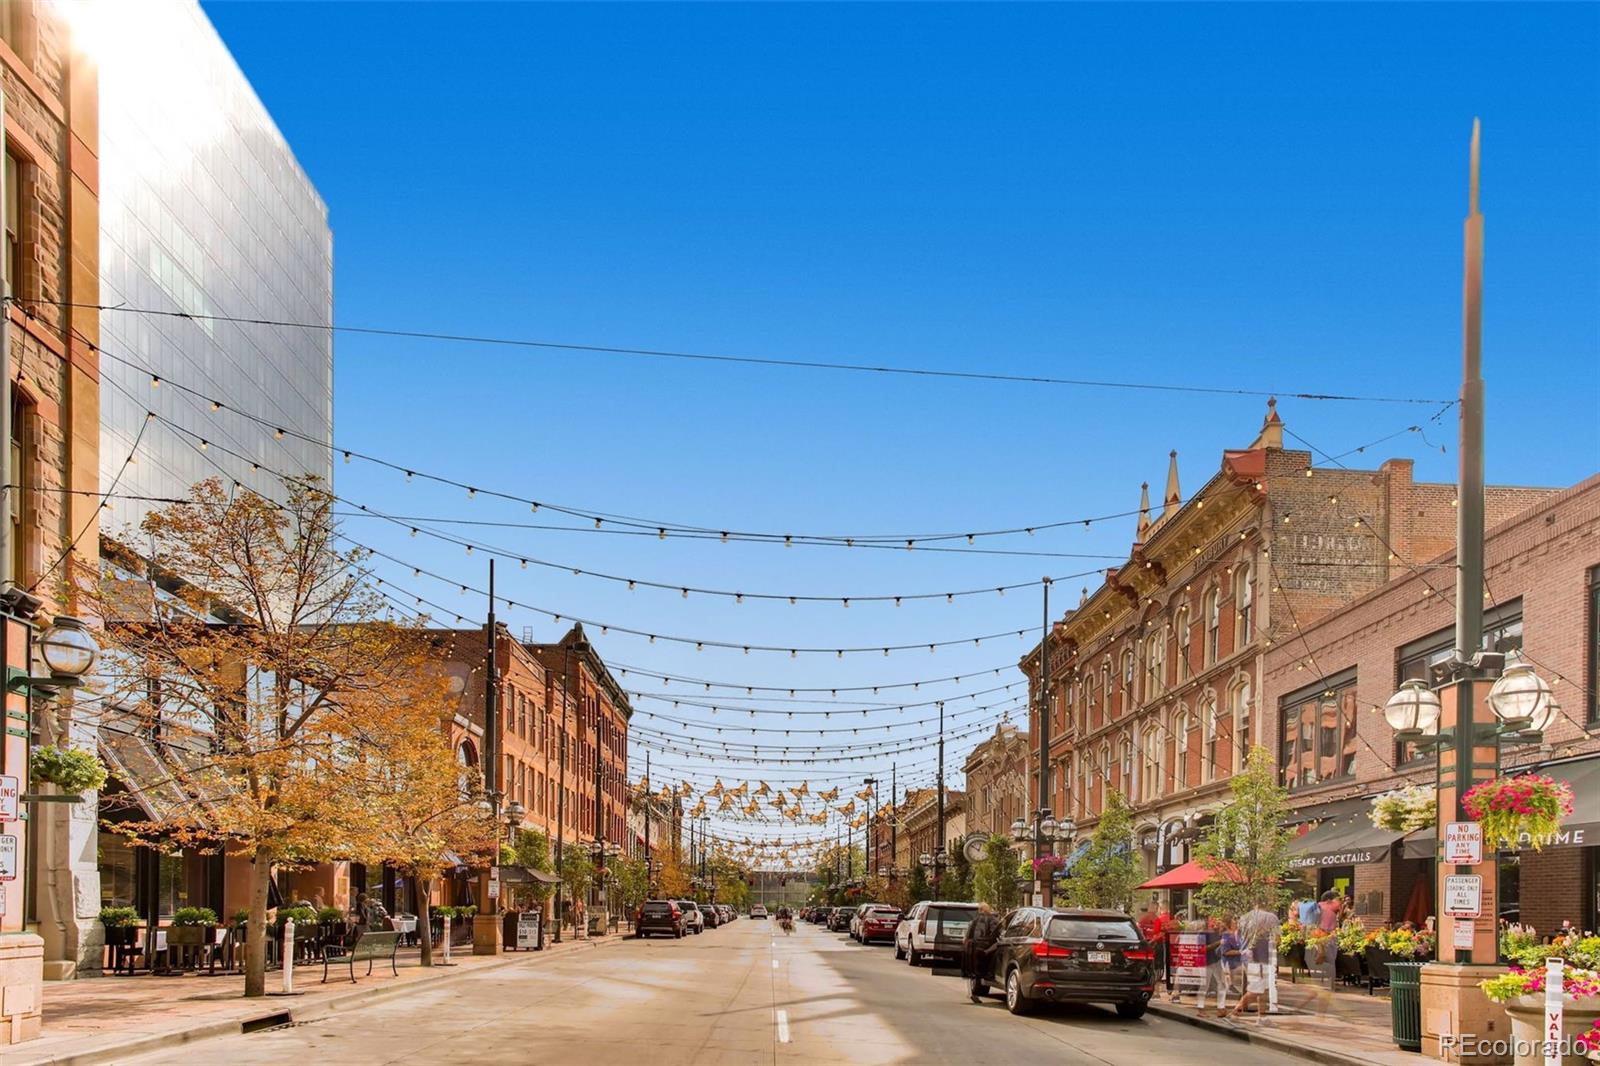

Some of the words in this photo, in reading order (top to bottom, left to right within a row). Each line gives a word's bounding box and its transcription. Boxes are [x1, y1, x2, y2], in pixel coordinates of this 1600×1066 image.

[1457, 825, 1469, 833] NO
[1447, 833, 1480, 842] PARKING
[1289, 857, 1317, 869] STEAKS
[1321, 852, 1372, 865] COCKTAILS
